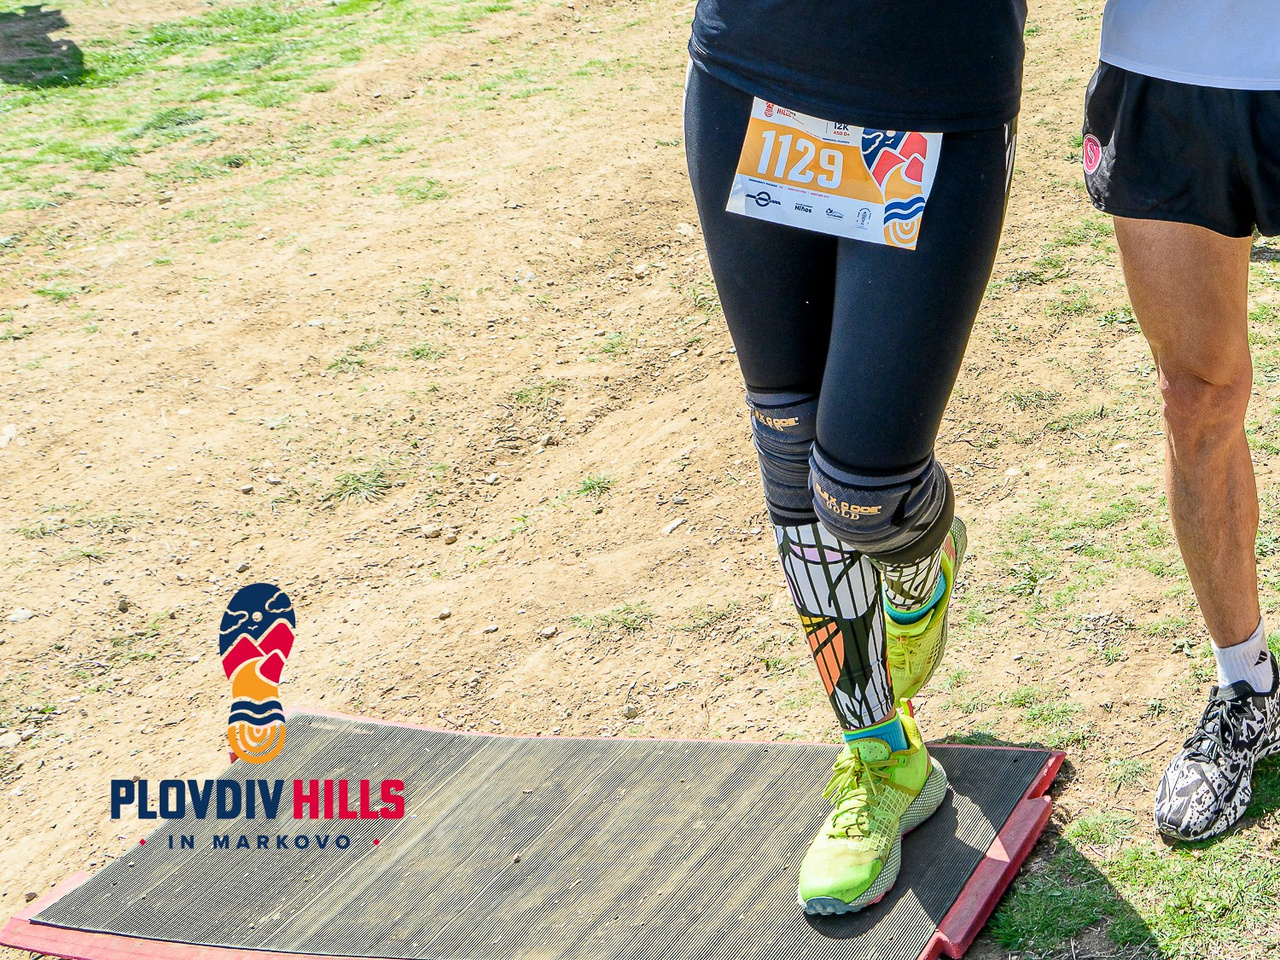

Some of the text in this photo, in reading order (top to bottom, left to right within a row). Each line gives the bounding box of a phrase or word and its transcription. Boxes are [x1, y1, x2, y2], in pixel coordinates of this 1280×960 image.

[834, 122, 849, 131] 12K
[757, 130, 844, 190] 1129
[826, 500, 860, 520] GOLD
